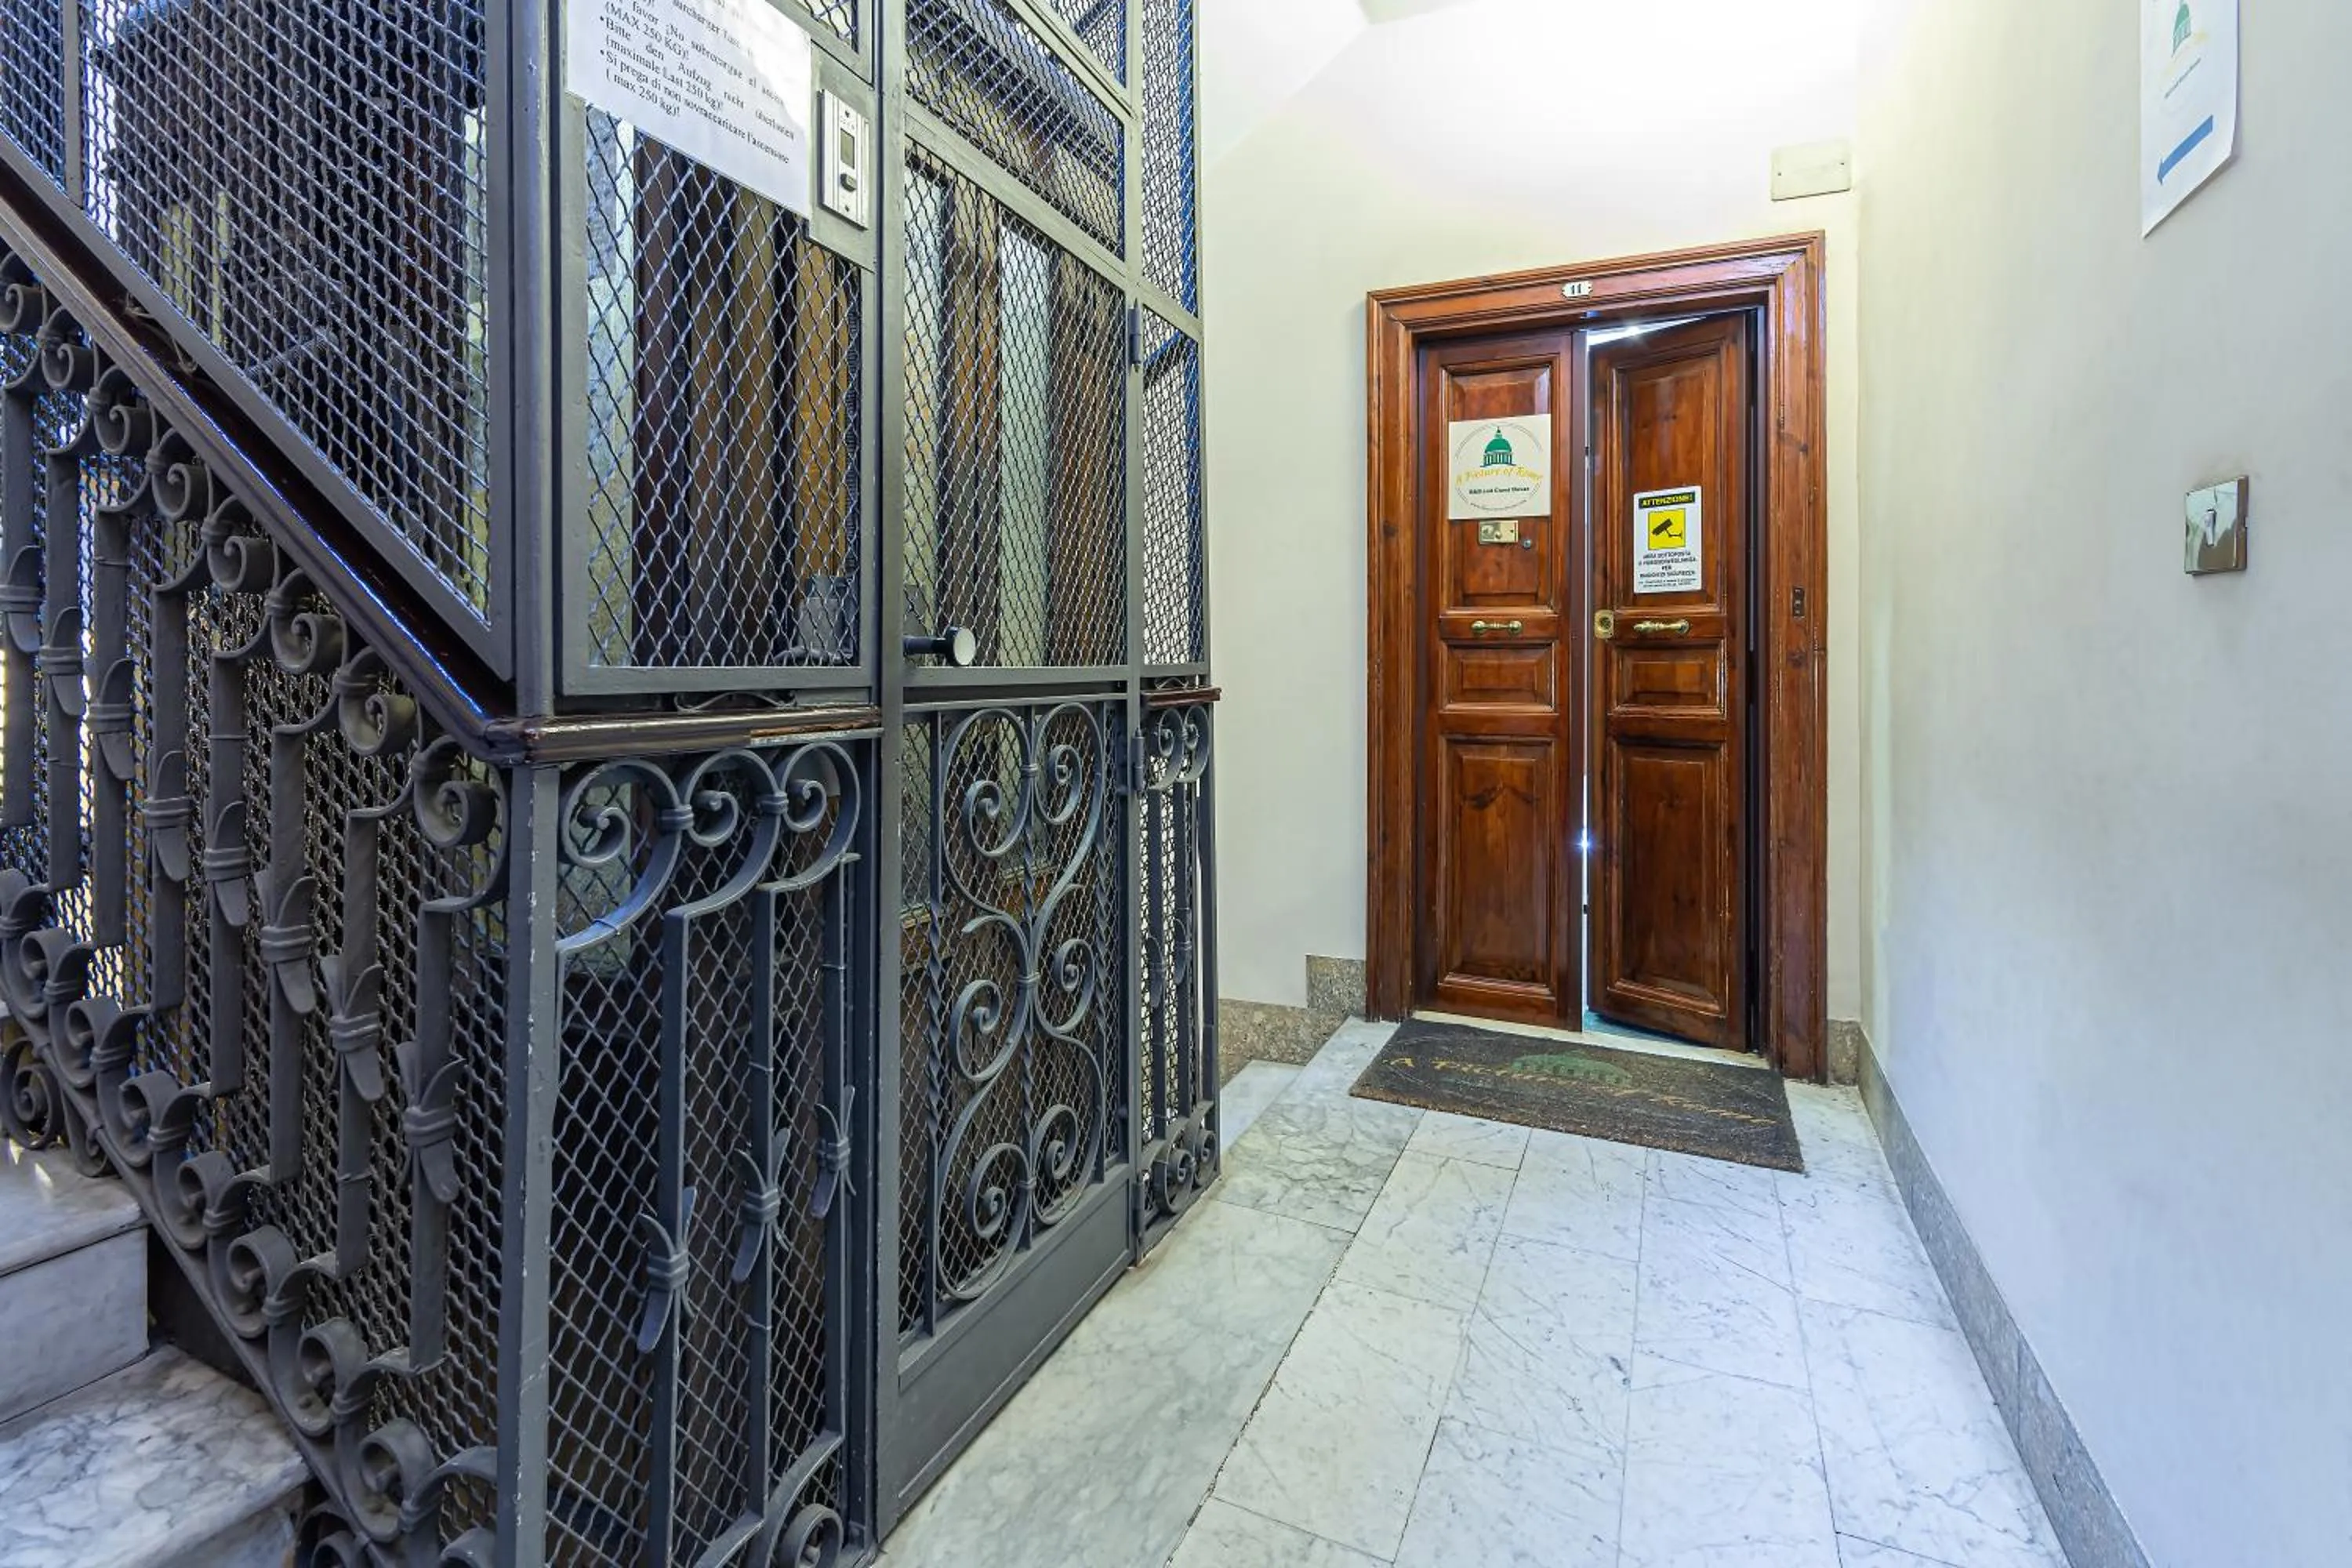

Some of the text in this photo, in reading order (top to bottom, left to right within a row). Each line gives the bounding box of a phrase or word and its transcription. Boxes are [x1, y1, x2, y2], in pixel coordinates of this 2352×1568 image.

[605, 2, 689, 60] (MAX 250 KG)!
[606, 16, 631, 42] Bitte
[645, 42, 665, 61] den
[678, 62, 712, 92] Aufzug
[633, 1, 659, 25] favor
[748, 76, 757, 89] el
[606, 34, 661, 74] (maximale
[662, 66, 684, 88] Last
[685, 81, 704, 98] 250
[606, 51, 618, 66] Si
[619, 61, 649, 84] prega
[651, 78, 662, 91] di
[663, 85, 682, 103] non
[683, 98, 746, 140] sovraccaricare
[614, 74, 637, 93] max
[639, 85, 659, 104] 250
[1570, 283, 1582, 296] 11
